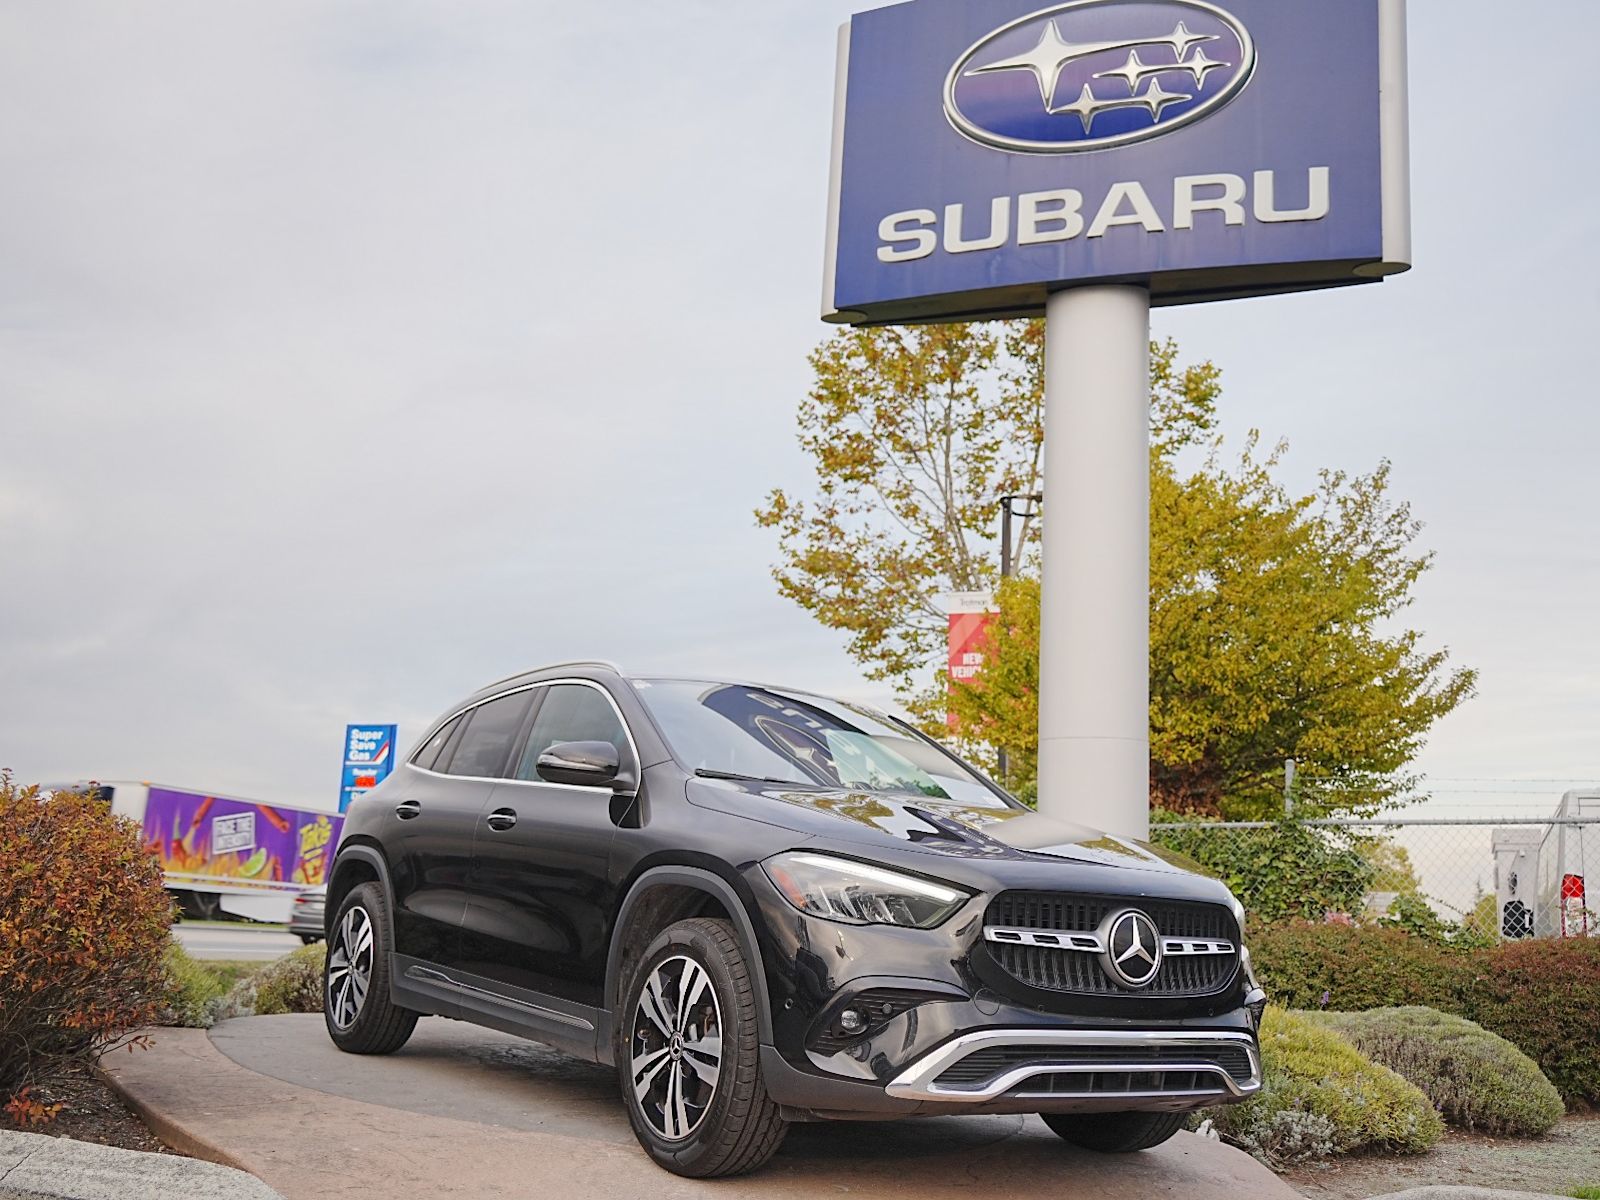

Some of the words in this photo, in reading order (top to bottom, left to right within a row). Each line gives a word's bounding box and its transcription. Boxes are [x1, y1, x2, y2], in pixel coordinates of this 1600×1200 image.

[877, 166, 1330, 263] SUBARU
[350, 729, 383, 741] Super
[349, 740, 376, 750] Save
[349, 750, 371, 760] Gas
